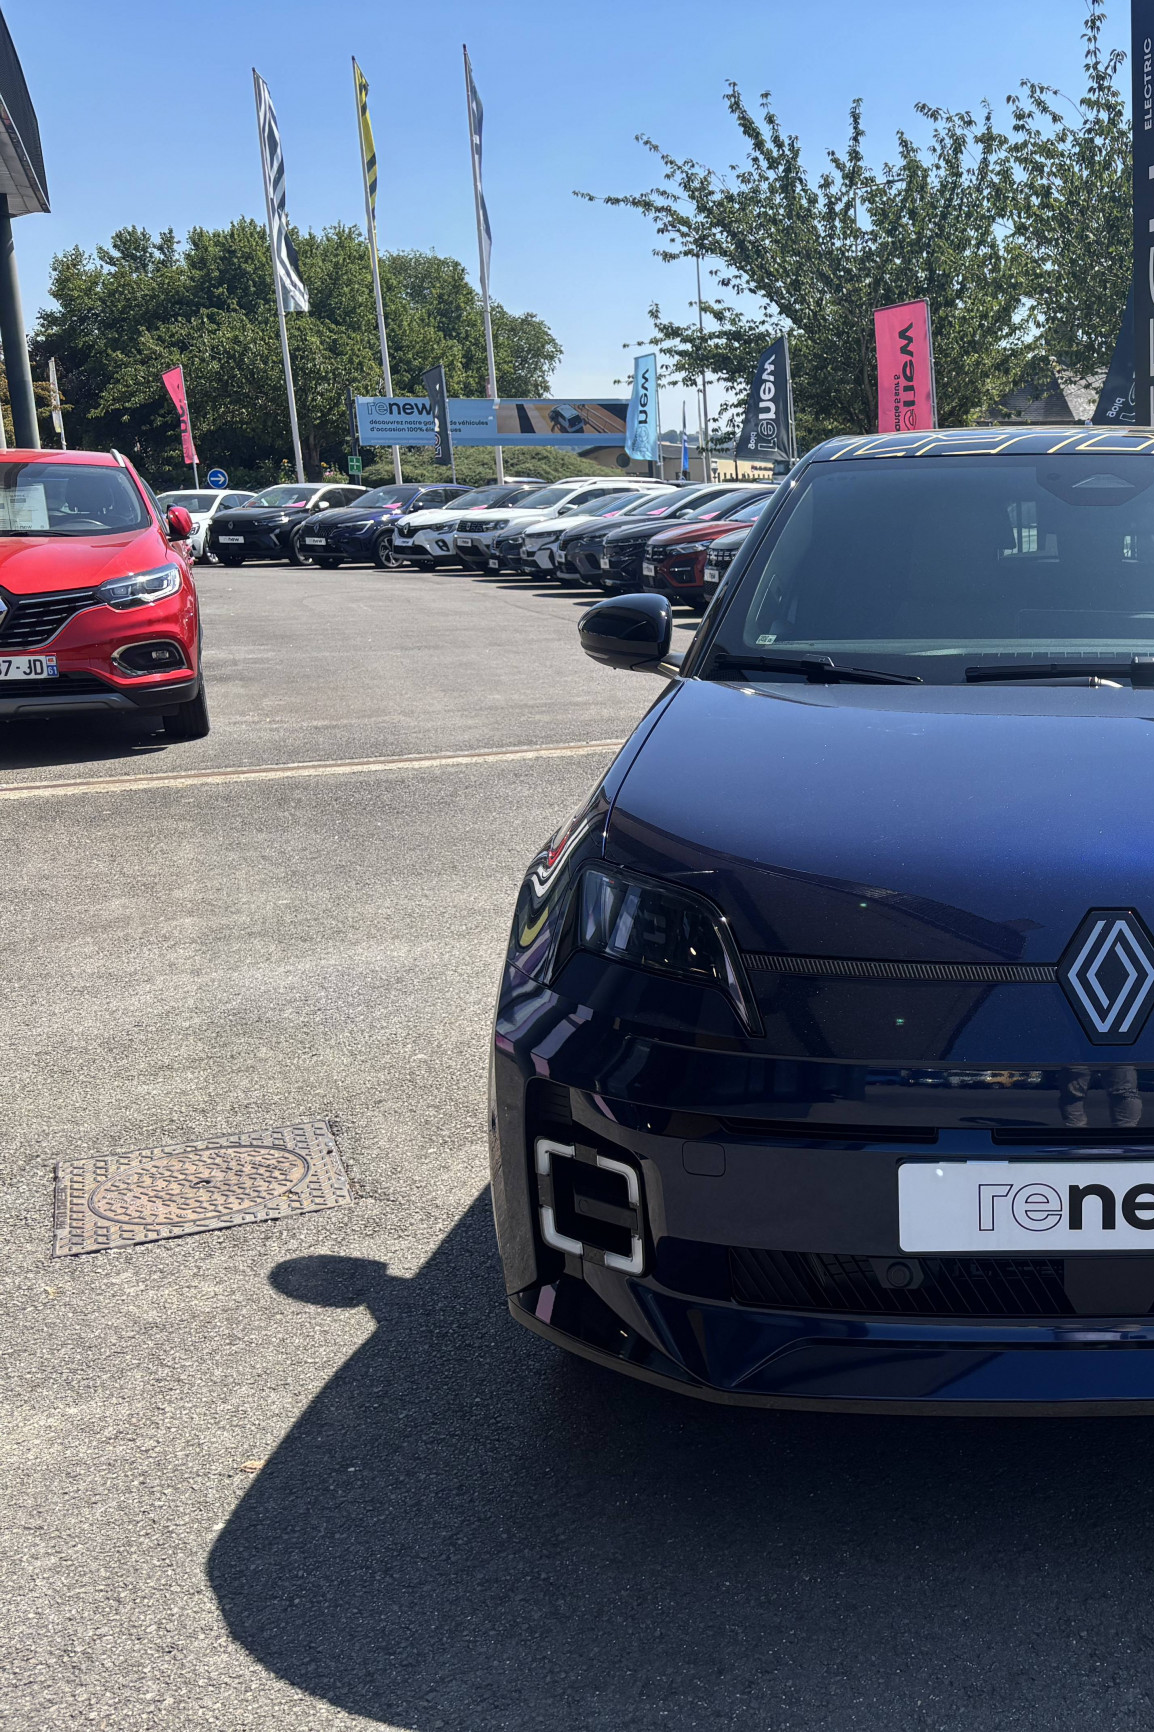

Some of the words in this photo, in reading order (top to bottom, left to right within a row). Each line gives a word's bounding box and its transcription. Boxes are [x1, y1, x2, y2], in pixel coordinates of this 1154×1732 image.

[1144, 38, 1152, 130] ELECTRIC
[367, 402, 433, 415] renew
[48, 666, 58, 675] 61
